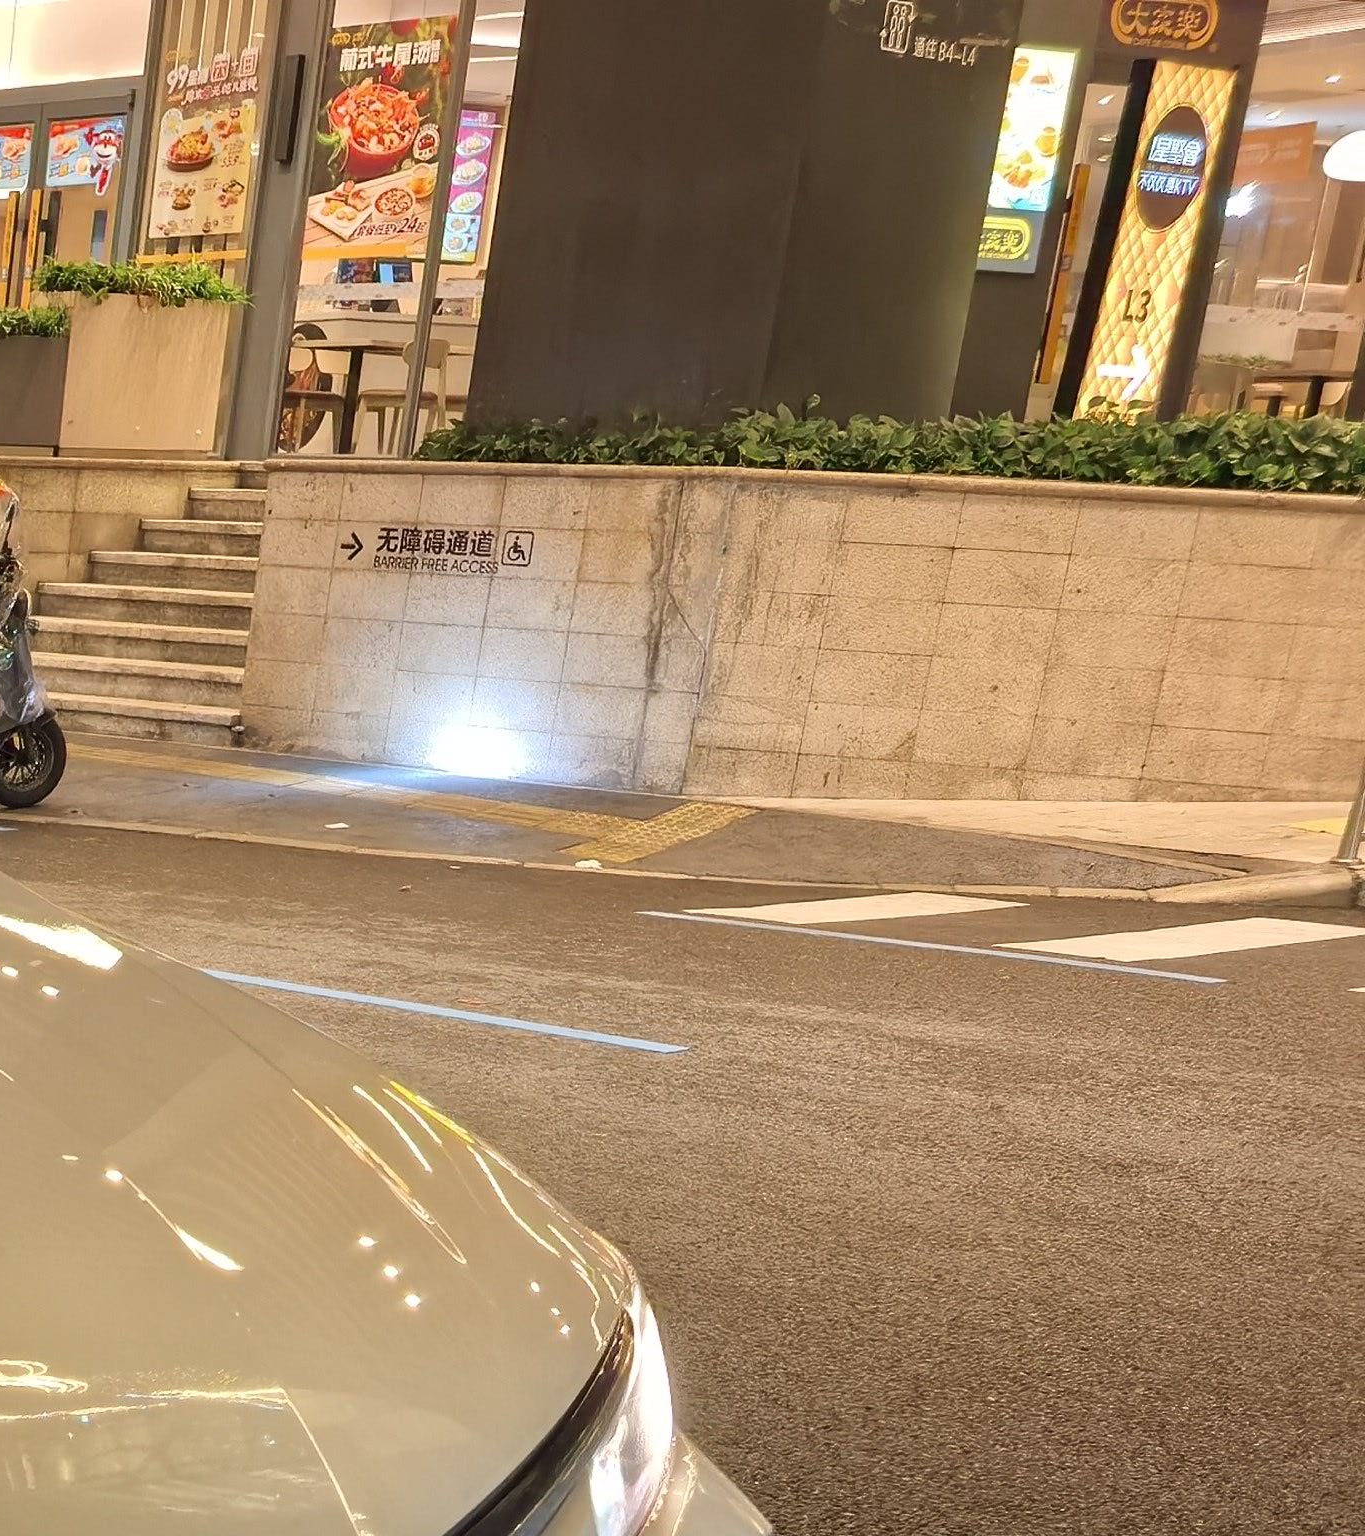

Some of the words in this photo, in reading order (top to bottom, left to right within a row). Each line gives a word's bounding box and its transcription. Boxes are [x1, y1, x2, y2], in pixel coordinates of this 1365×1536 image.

[979, 229, 1025, 254] 家樂
[1122, 289, 1152, 323] L3
[376, 527, 495, 557] 无障碍通道
[373, 556, 419, 570] BARRIER
[421, 558, 449, 572] FREE
[450, 560, 499, 574] ACCESS
